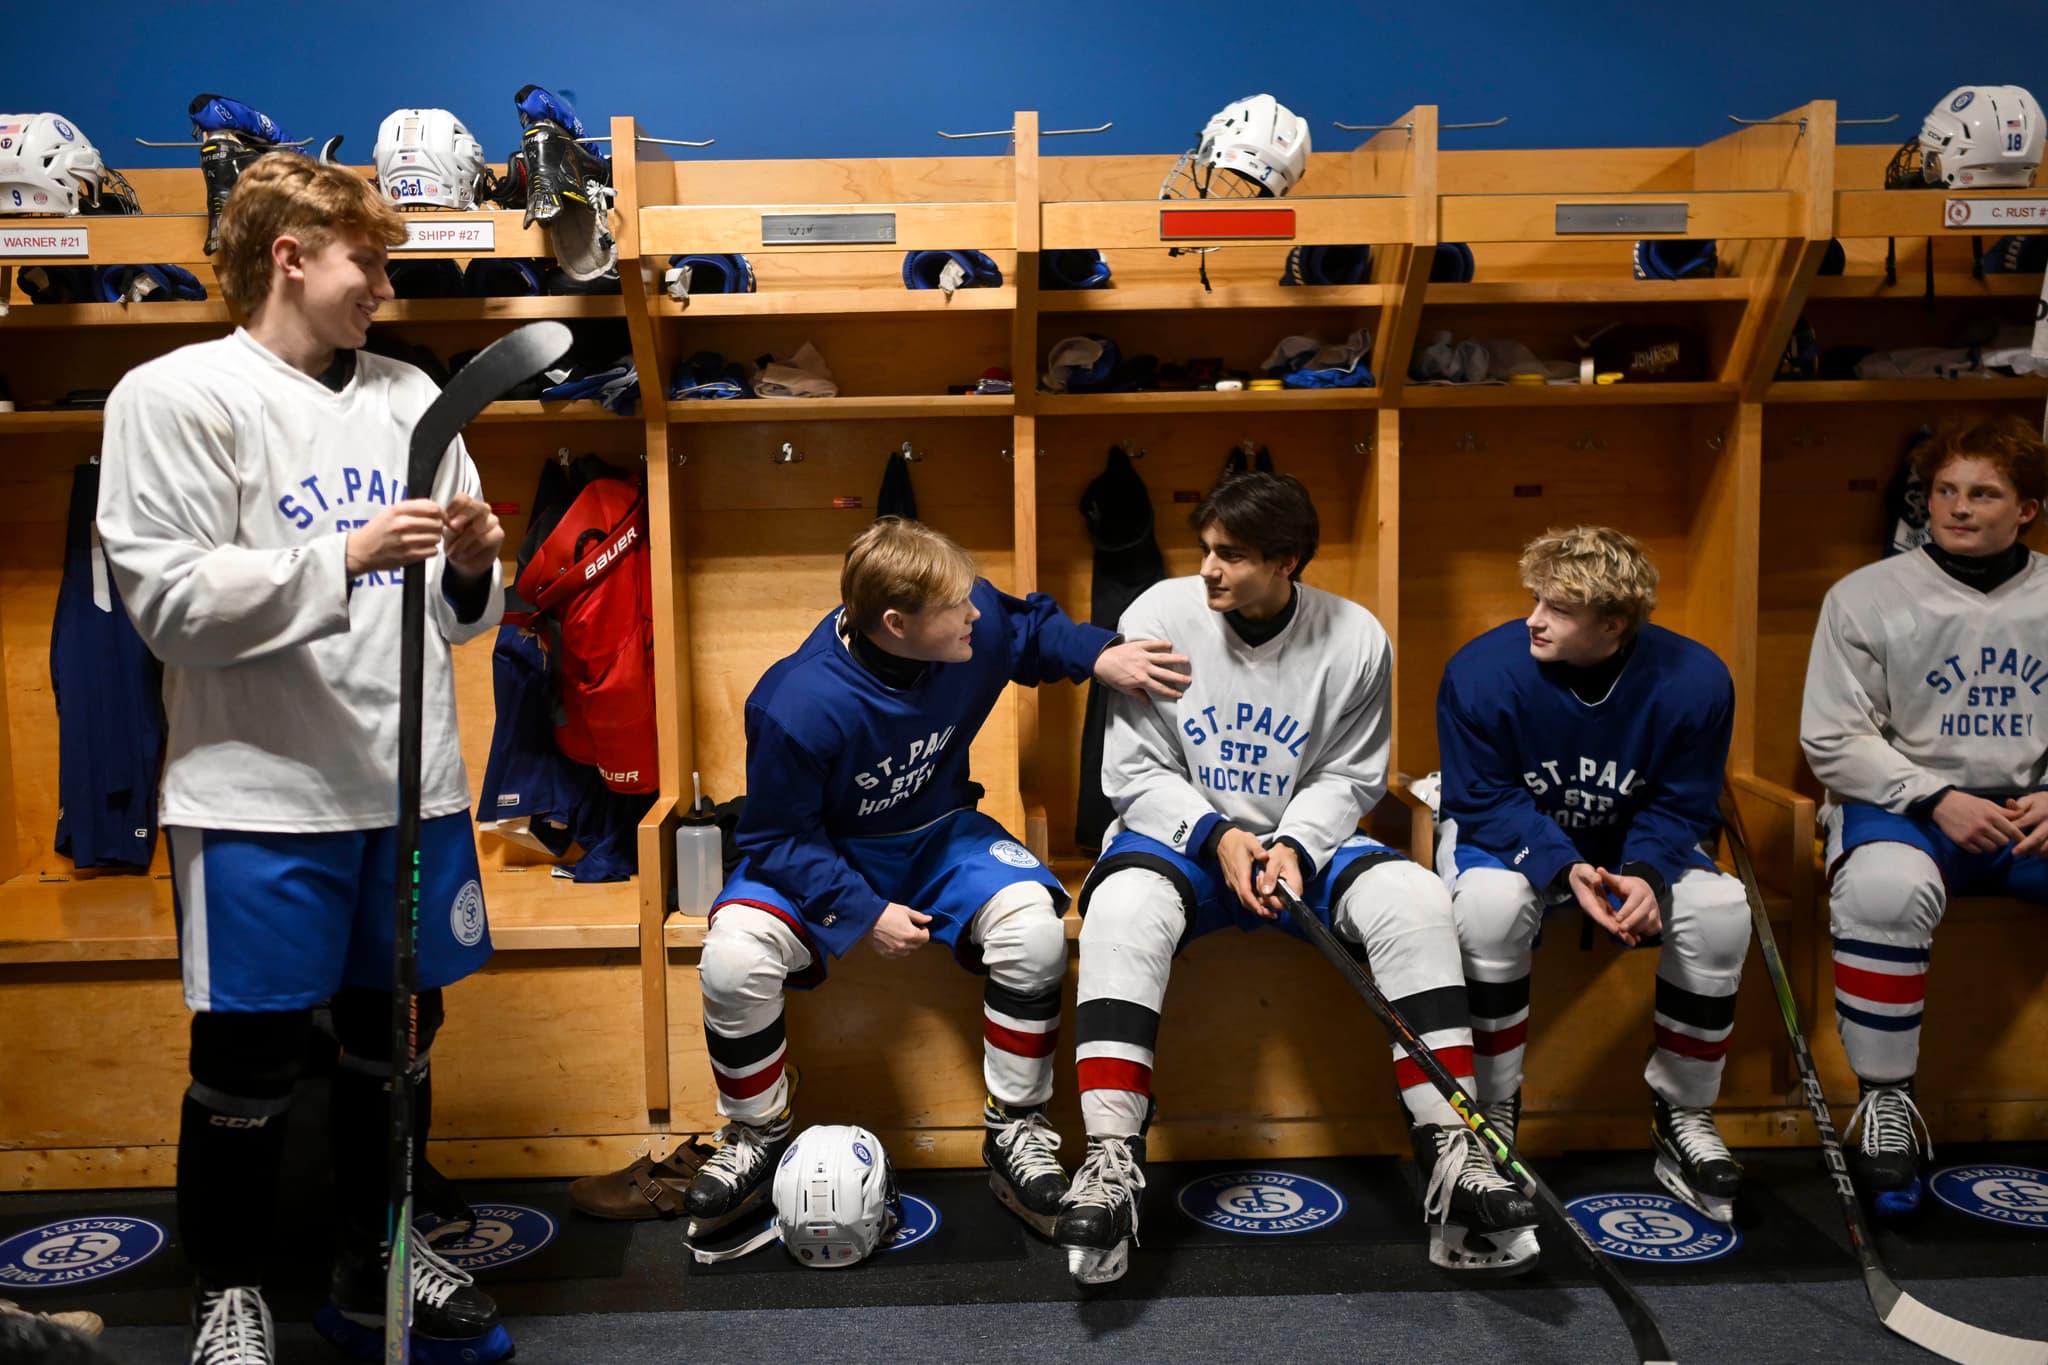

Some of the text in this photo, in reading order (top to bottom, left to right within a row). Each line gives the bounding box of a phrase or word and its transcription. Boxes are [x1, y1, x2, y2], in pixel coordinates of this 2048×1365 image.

[2007, 133, 2022, 151] 18
[1260, 166, 1272, 181] 3
[12, 190, 22, 206] 9
[1992, 207, 2002, 217] C.
[2006, 207, 2037, 217] RUST
[4, 237, 80, 247] WARNER #21
[418, 230, 456, 240] SHIPP
[459, 230, 480, 240] #27
[584, 526, 638, 580] BAUER
[1967, 686, 2016, 706] STP
[1940, 714, 2032, 736] HOCKEY
[1220, 740, 1267, 765] STP
[1198, 765, 1290, 796] HOCKEY
[1564, 789, 1614, 812] STP
[209, 1114, 269, 1128] CCM
[1951, 1168, 2040, 1182] HOCKEY
[1581, 1199, 1673, 1213] HOCKEY
[1979, 1204, 2047, 1223] PAUL
[1205, 1207, 1327, 1230] SAINT PAUL
[40, 1221, 136, 1239] HOCKEY
[1597, 1232, 1723, 1257] SAINT PAUL
[49, 1255, 131, 1281] SAINT
